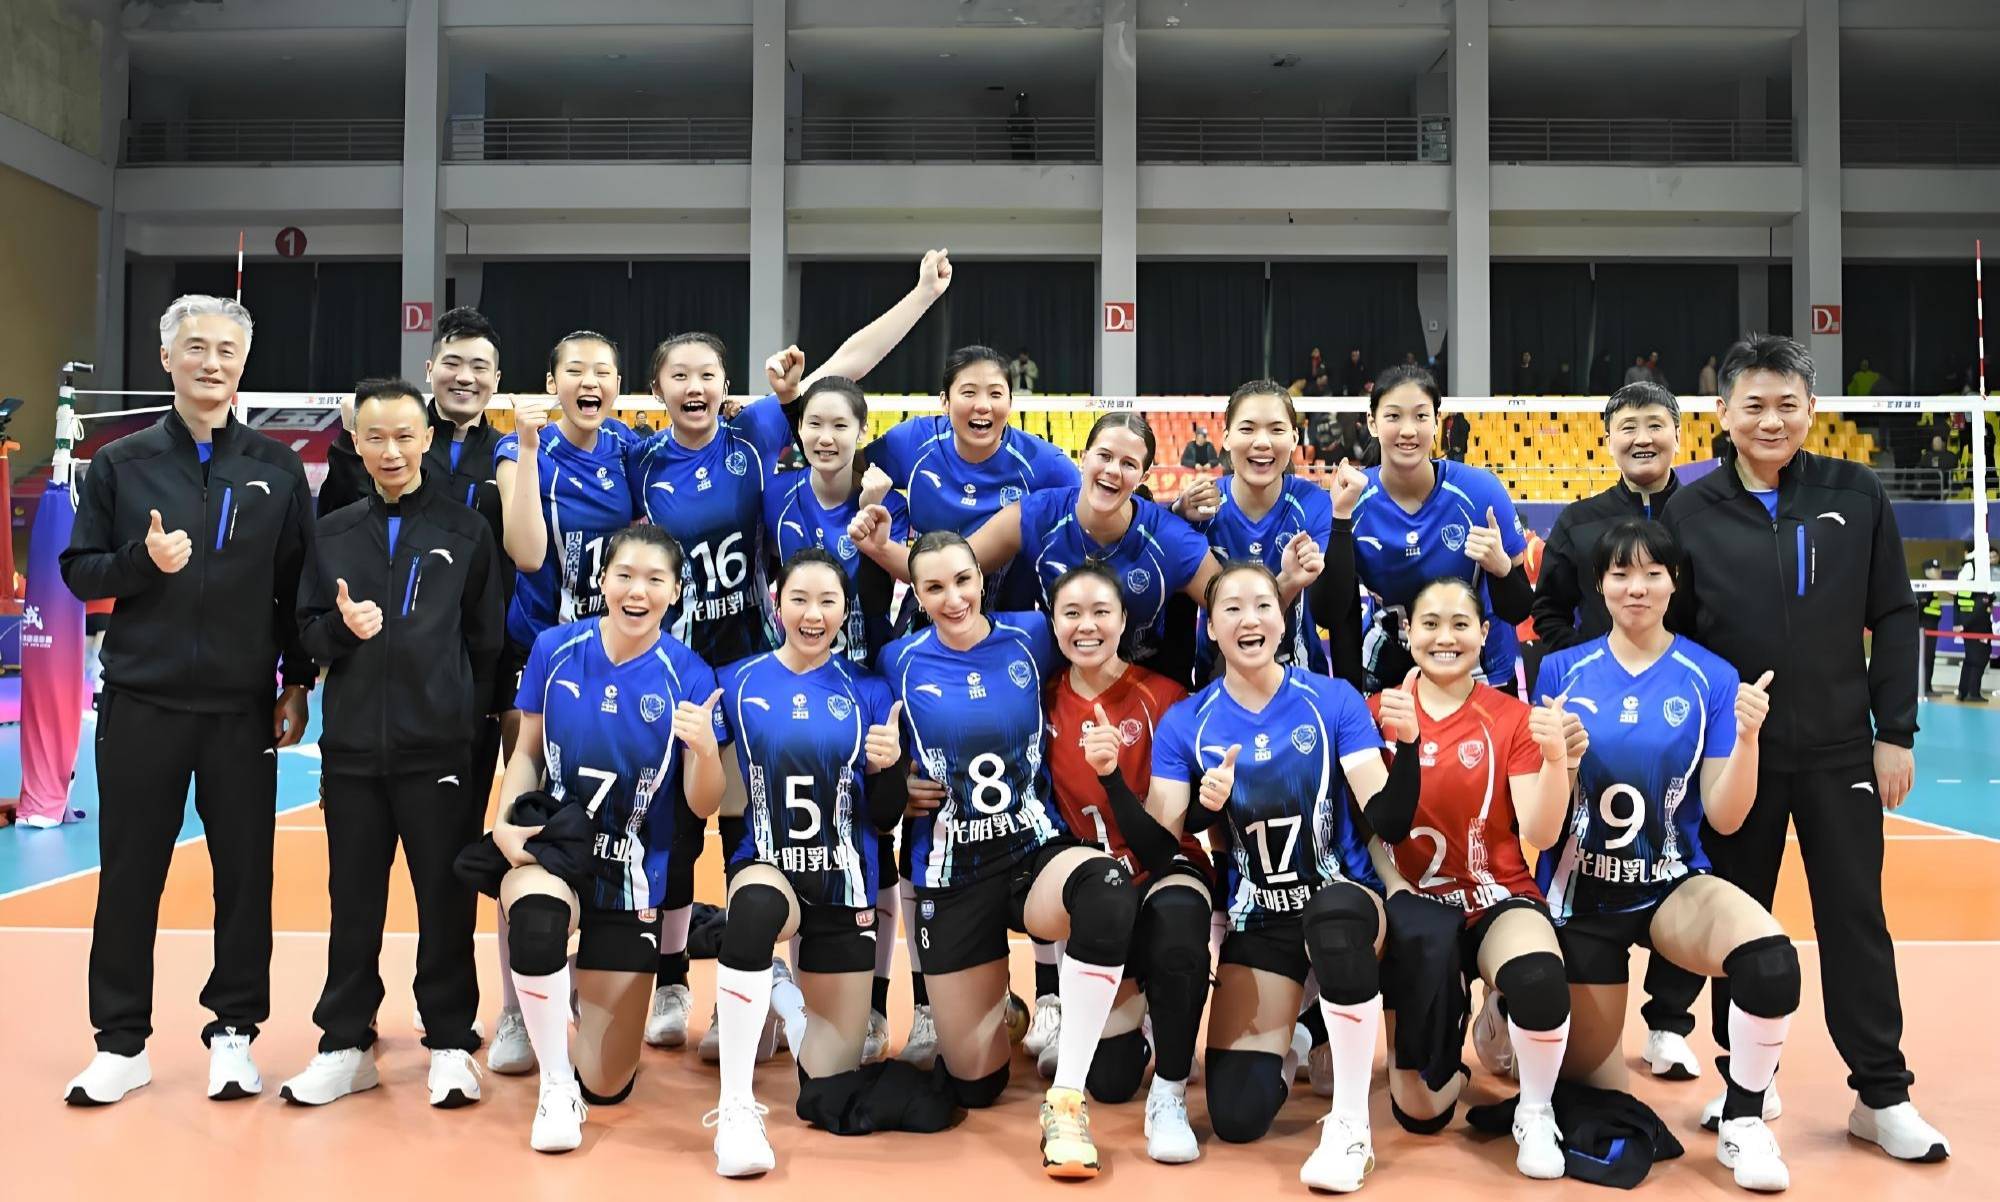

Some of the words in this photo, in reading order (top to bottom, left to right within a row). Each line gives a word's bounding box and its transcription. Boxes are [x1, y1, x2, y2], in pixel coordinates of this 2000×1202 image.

[284, 231, 296, 256] 1
[405, 304, 424, 330] D
[1106, 305, 1126, 330] D
[1813, 308, 1833, 332] D
[585, 536, 614, 589] 1
[690, 531, 748, 592] 16
[578, 766, 618, 819] 7
[968, 752, 1012, 814] 8
[786, 775, 821, 839] 5
[946, 812, 1036, 844] 光明乳业
[1599, 783, 1646, 849] 9
[593, 832, 634, 863] 乳业
[1245, 815, 1302, 874] 17
[1409, 826, 1457, 889] 2
[1253, 884, 1321, 913] 光明乳
[921, 927, 930, 949] 8
